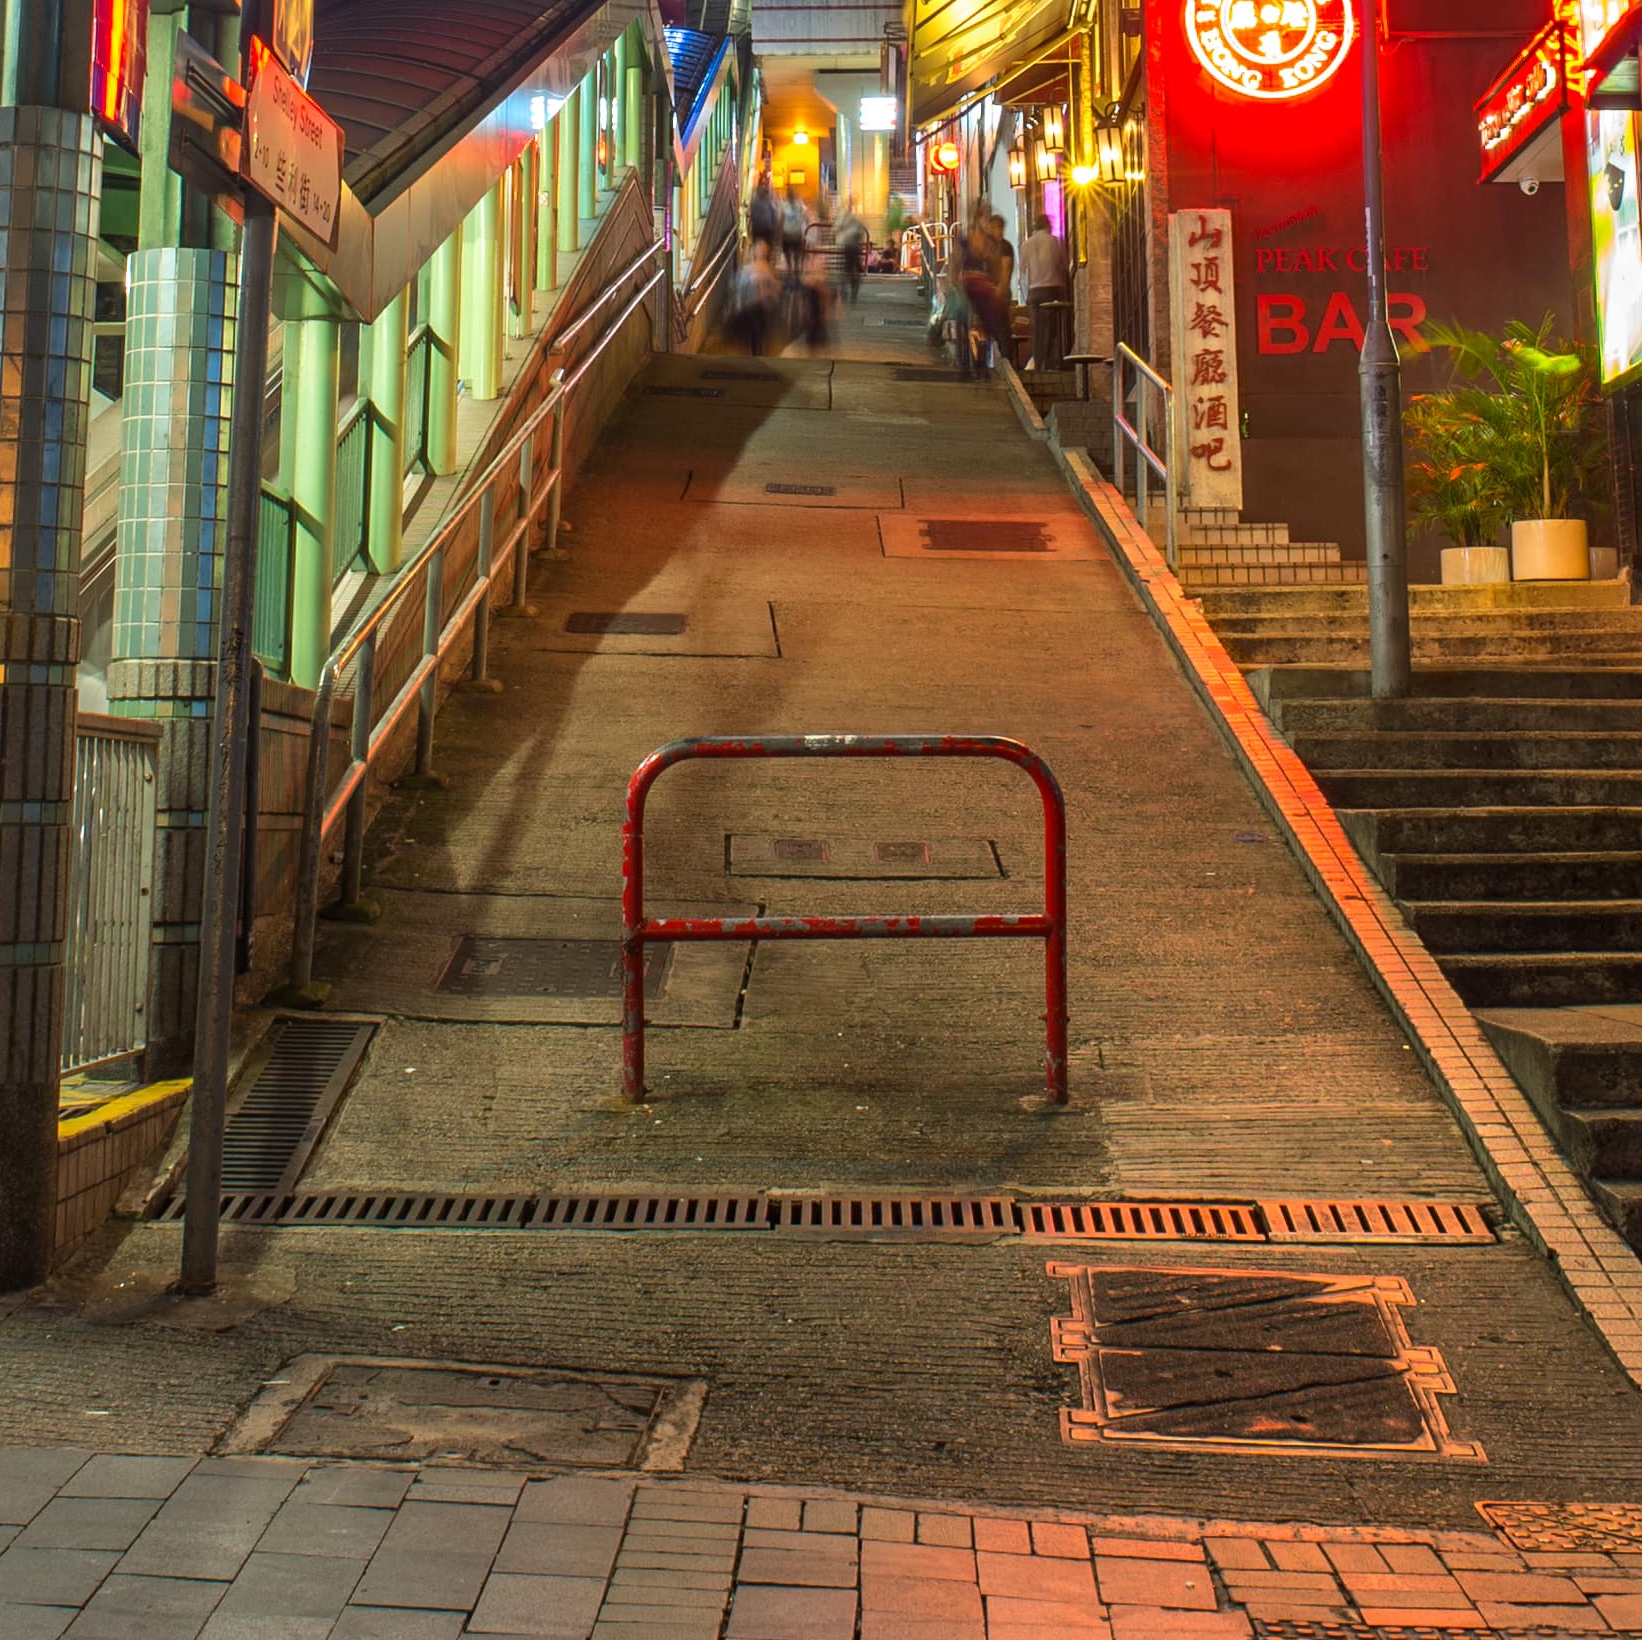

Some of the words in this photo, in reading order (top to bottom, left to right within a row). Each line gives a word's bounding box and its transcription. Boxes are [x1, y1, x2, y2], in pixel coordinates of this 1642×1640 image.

[272, 74, 299, 129] Shelley
[299, 110, 323, 152] Street
[1256, 247, 1339, 274] PEAK
[1346, 247, 1430, 273] CFE
[1188, 214, 1232, 472] 山頂餐廳酒吧
